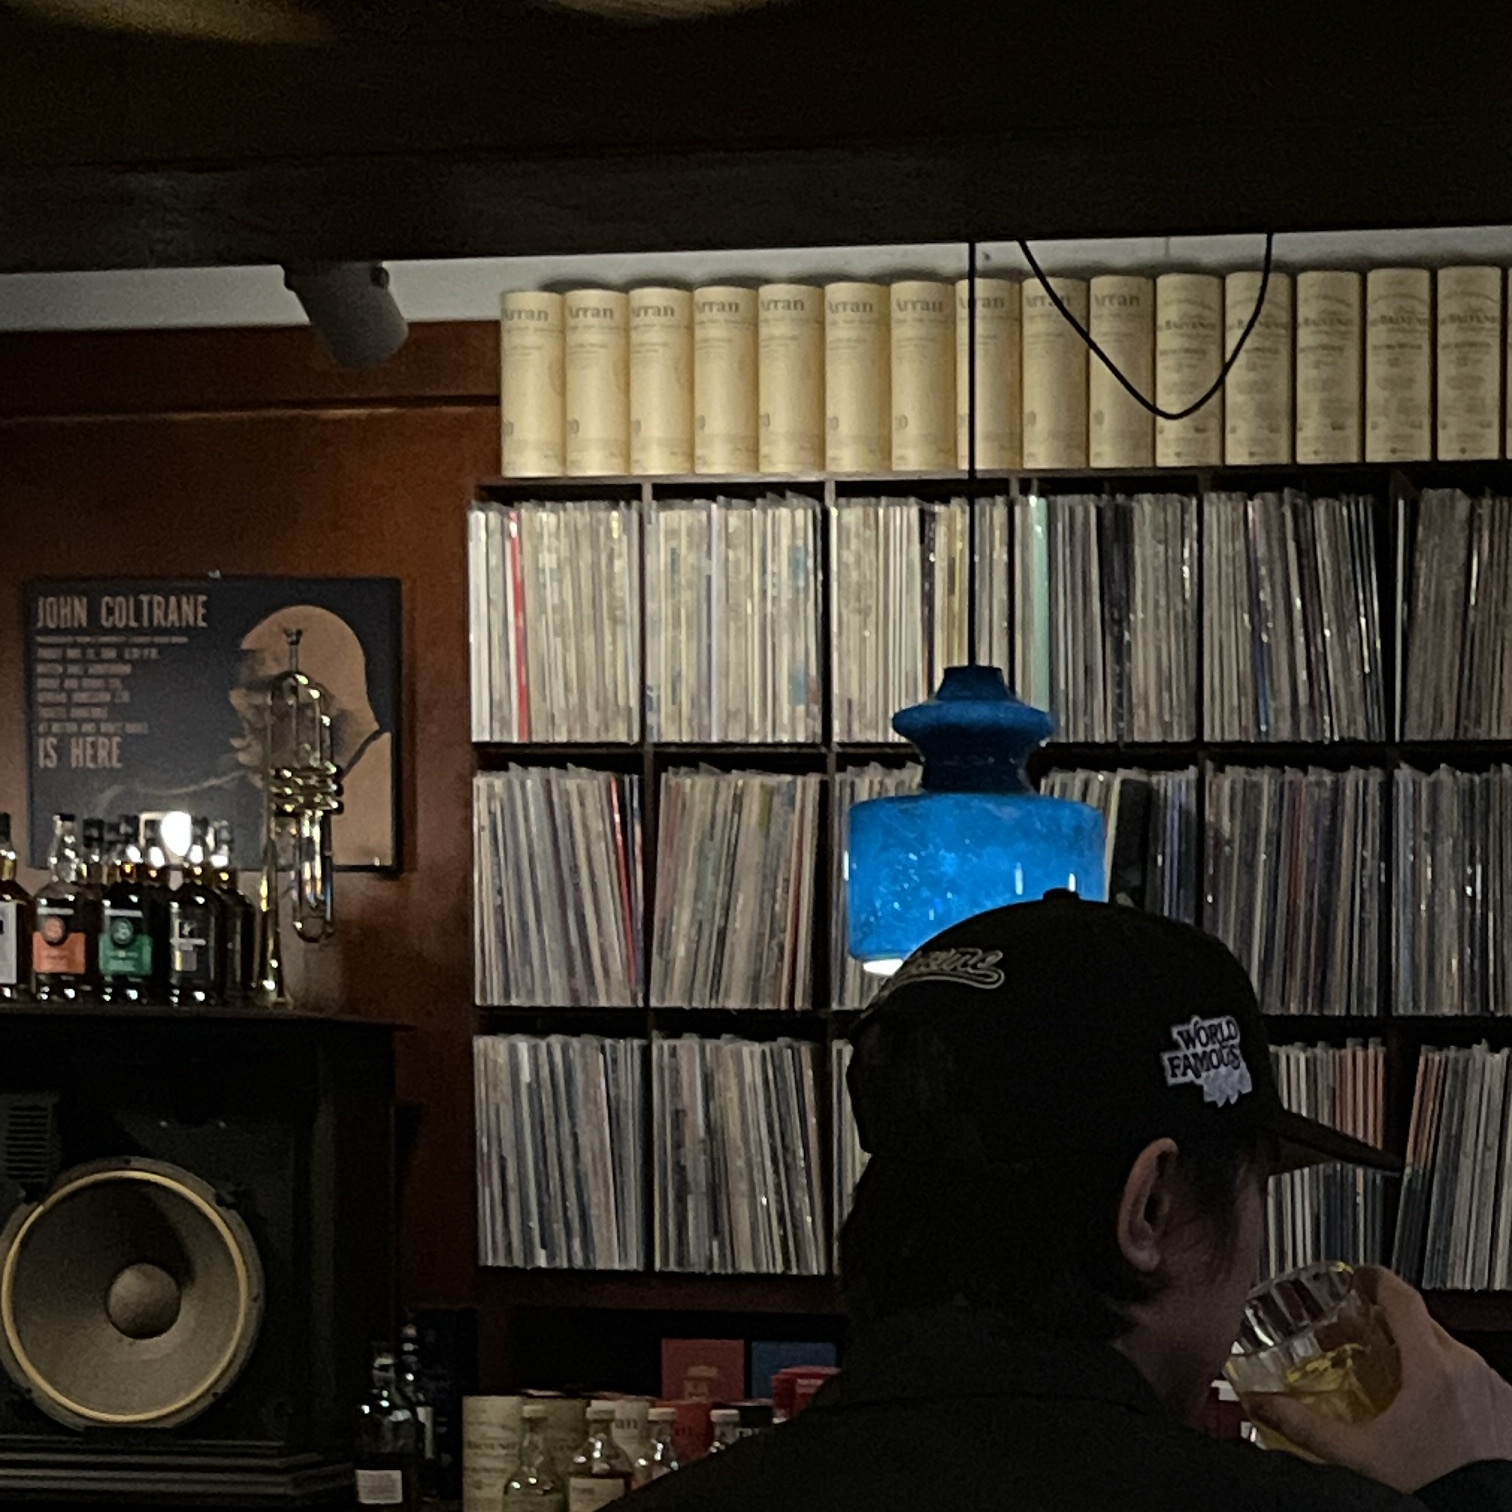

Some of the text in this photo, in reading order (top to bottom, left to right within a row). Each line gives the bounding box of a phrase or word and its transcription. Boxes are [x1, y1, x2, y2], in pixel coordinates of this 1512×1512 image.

[36, 593, 209, 630] JOHN COLTRANE
[38, 736, 124, 770] IS HERE
[1177, 1020, 1238, 1051] WORLD
[1168, 1044, 1241, 1080] FAMOUS
